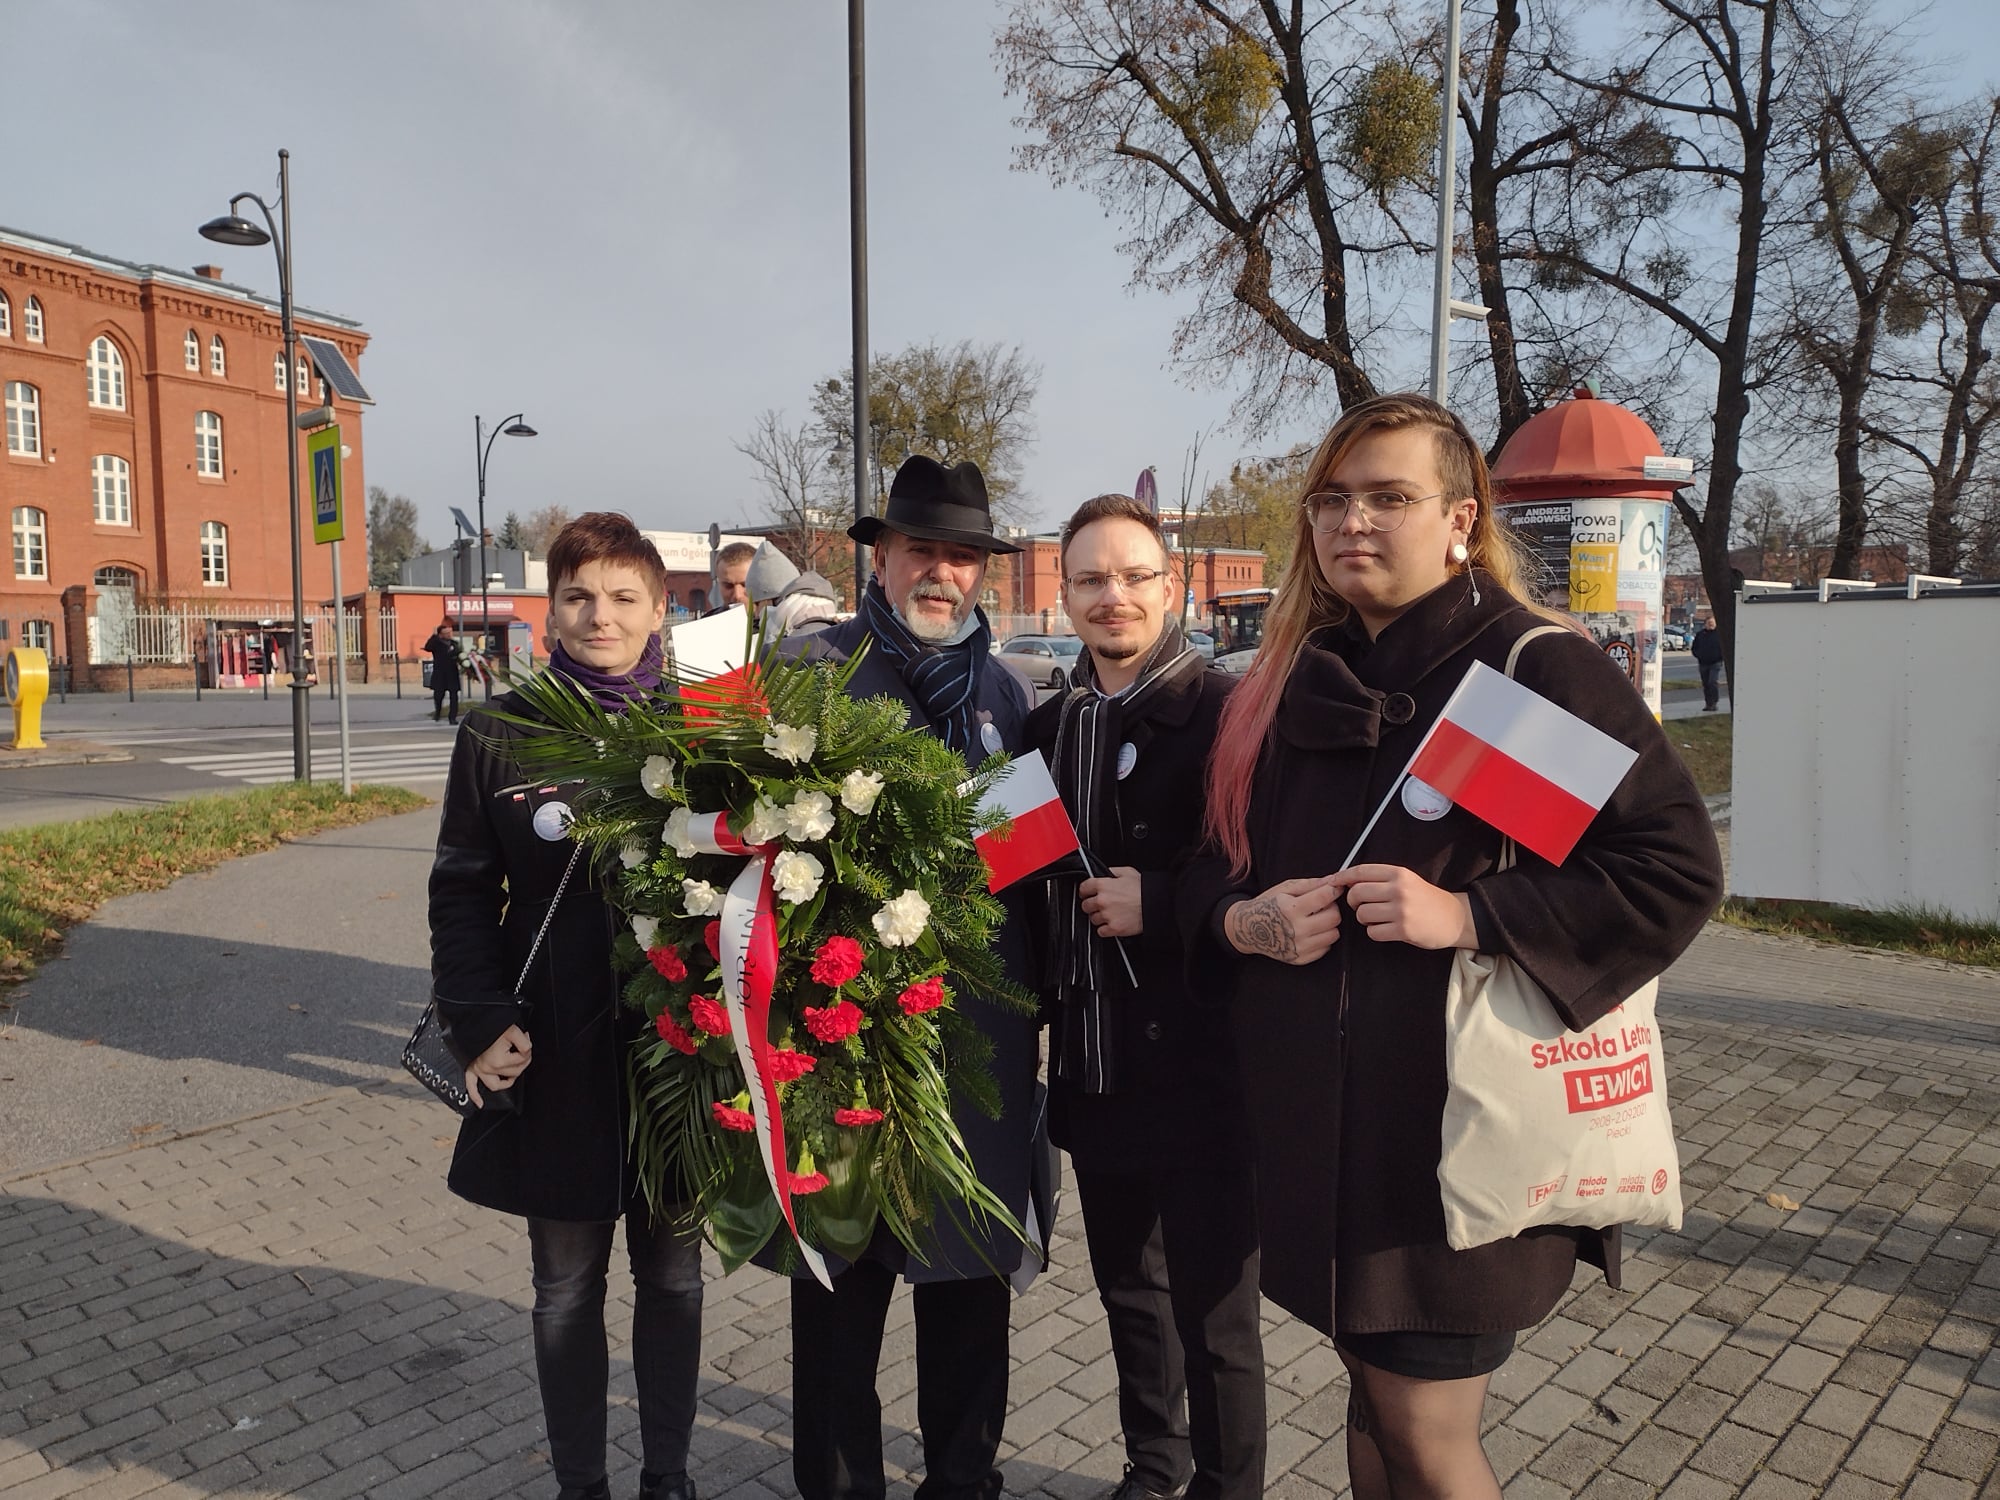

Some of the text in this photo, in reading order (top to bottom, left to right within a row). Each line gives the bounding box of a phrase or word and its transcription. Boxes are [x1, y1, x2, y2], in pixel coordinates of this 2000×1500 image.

[1526, 506, 1571, 516] ANDRZEJ
[1511, 514, 1571, 526] SIKOROWSKI
[1531, 1023, 1652, 1069] Szkoła Letnia
[1575, 1060, 1648, 1105] LEWICY
[1575, 1186, 1605, 1197] lewica
